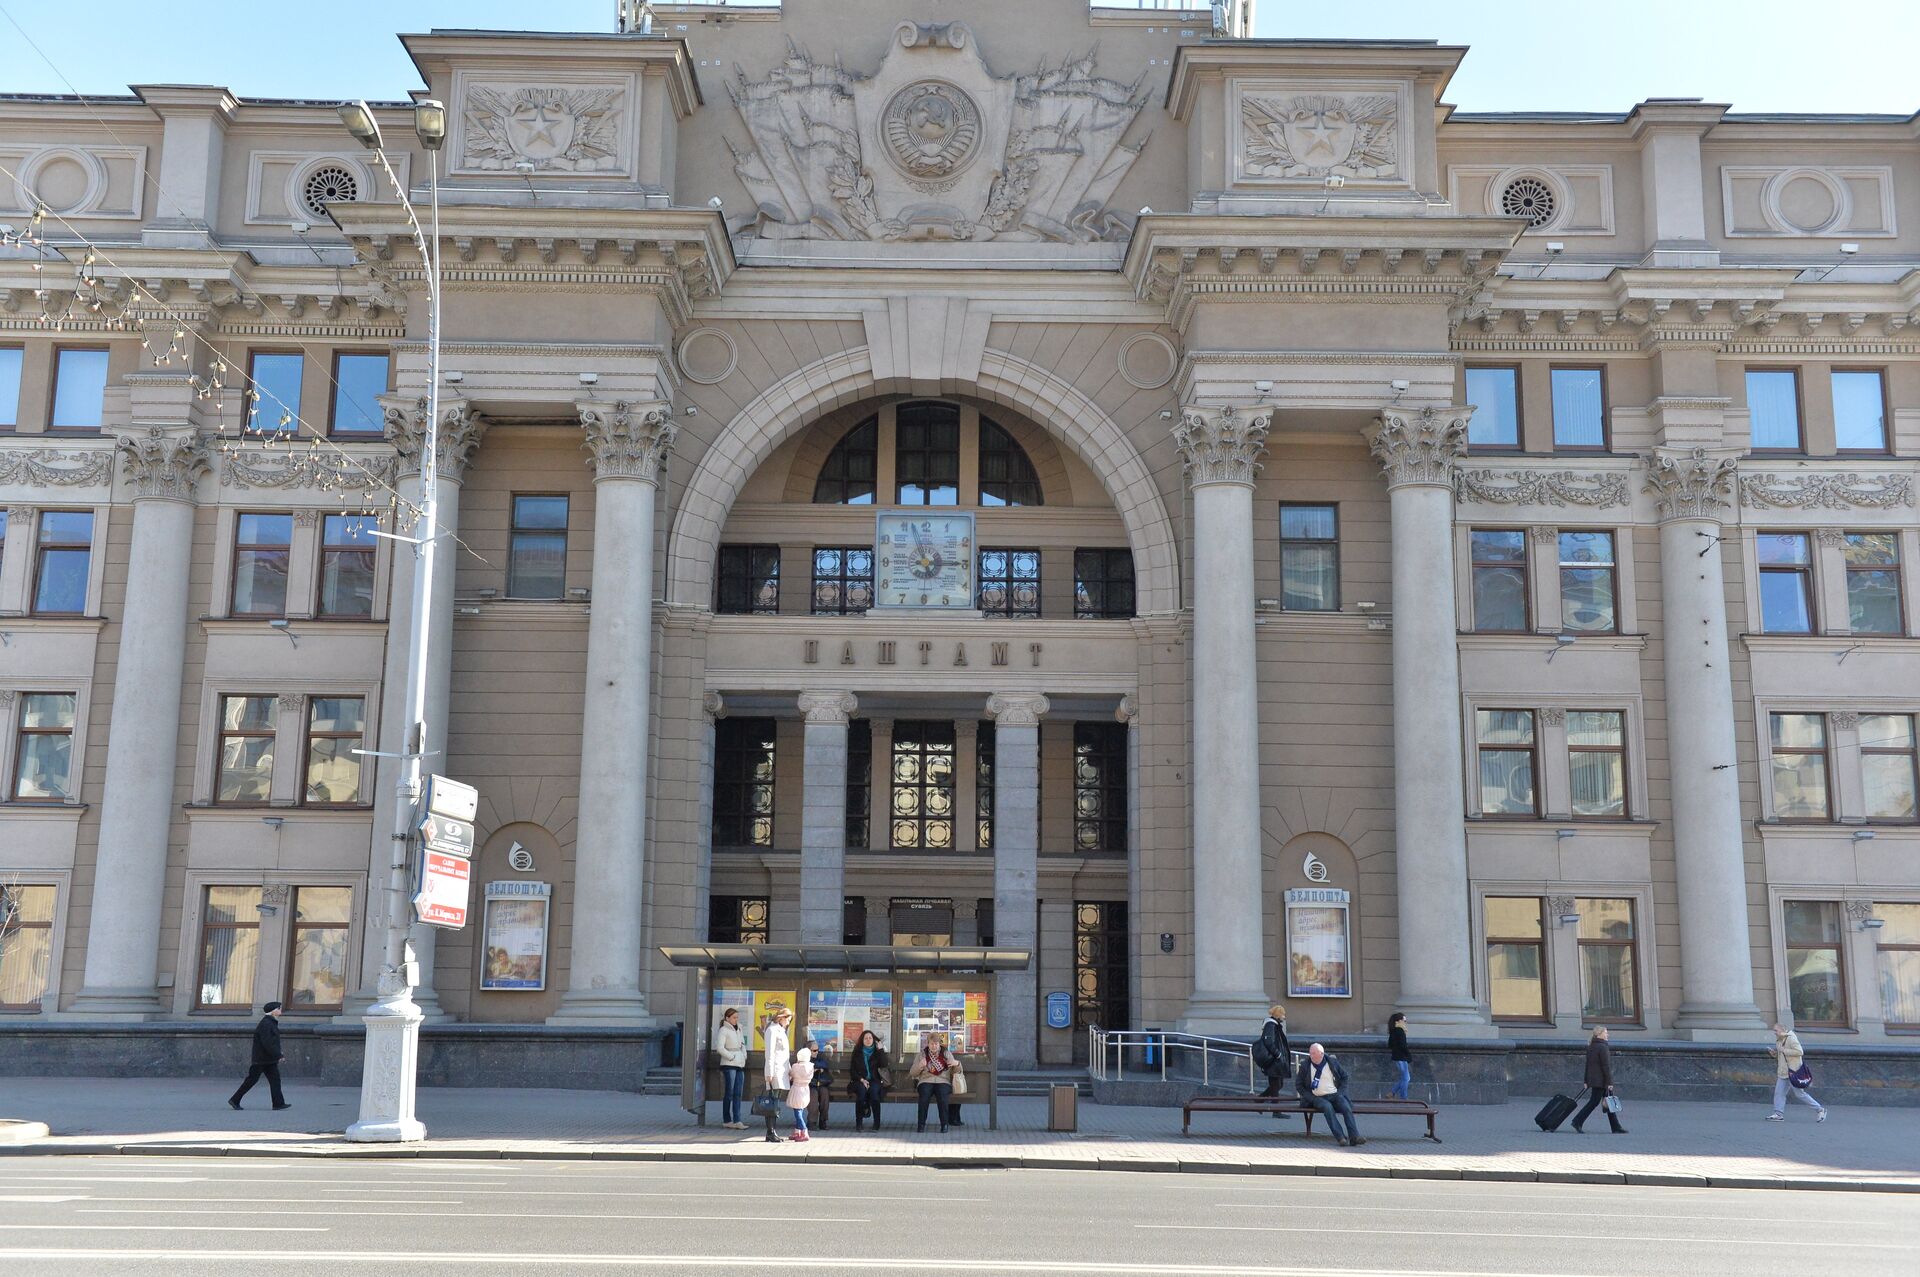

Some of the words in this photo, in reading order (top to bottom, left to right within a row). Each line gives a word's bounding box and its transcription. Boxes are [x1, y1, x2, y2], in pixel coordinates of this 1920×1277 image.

[803, 639, 1043, 667] ПАШТАМТ
[488, 882, 545, 895] БЕЛПОШТА
[1290, 890, 1346, 902] БЕЛПОШТА
